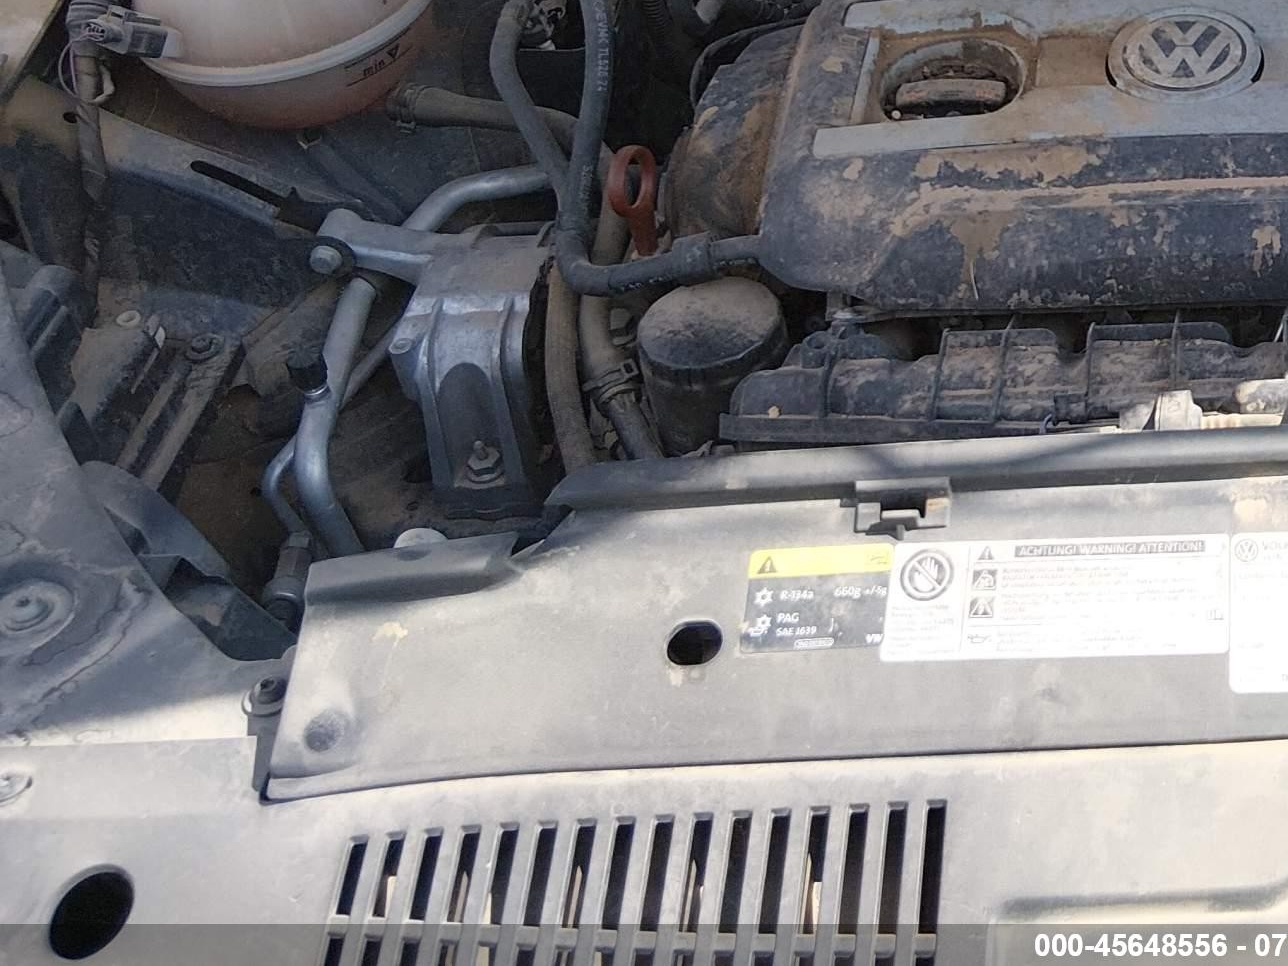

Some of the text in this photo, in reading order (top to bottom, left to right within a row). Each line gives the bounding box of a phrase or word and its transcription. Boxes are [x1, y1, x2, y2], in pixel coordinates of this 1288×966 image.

[362, 58, 386, 77] min
[1019, 540, 1205, 556] ACHTUNG! WARNING! ATTENTION!
[776, 612, 800, 624] PAG
[776, 626, 794, 636] SAE
